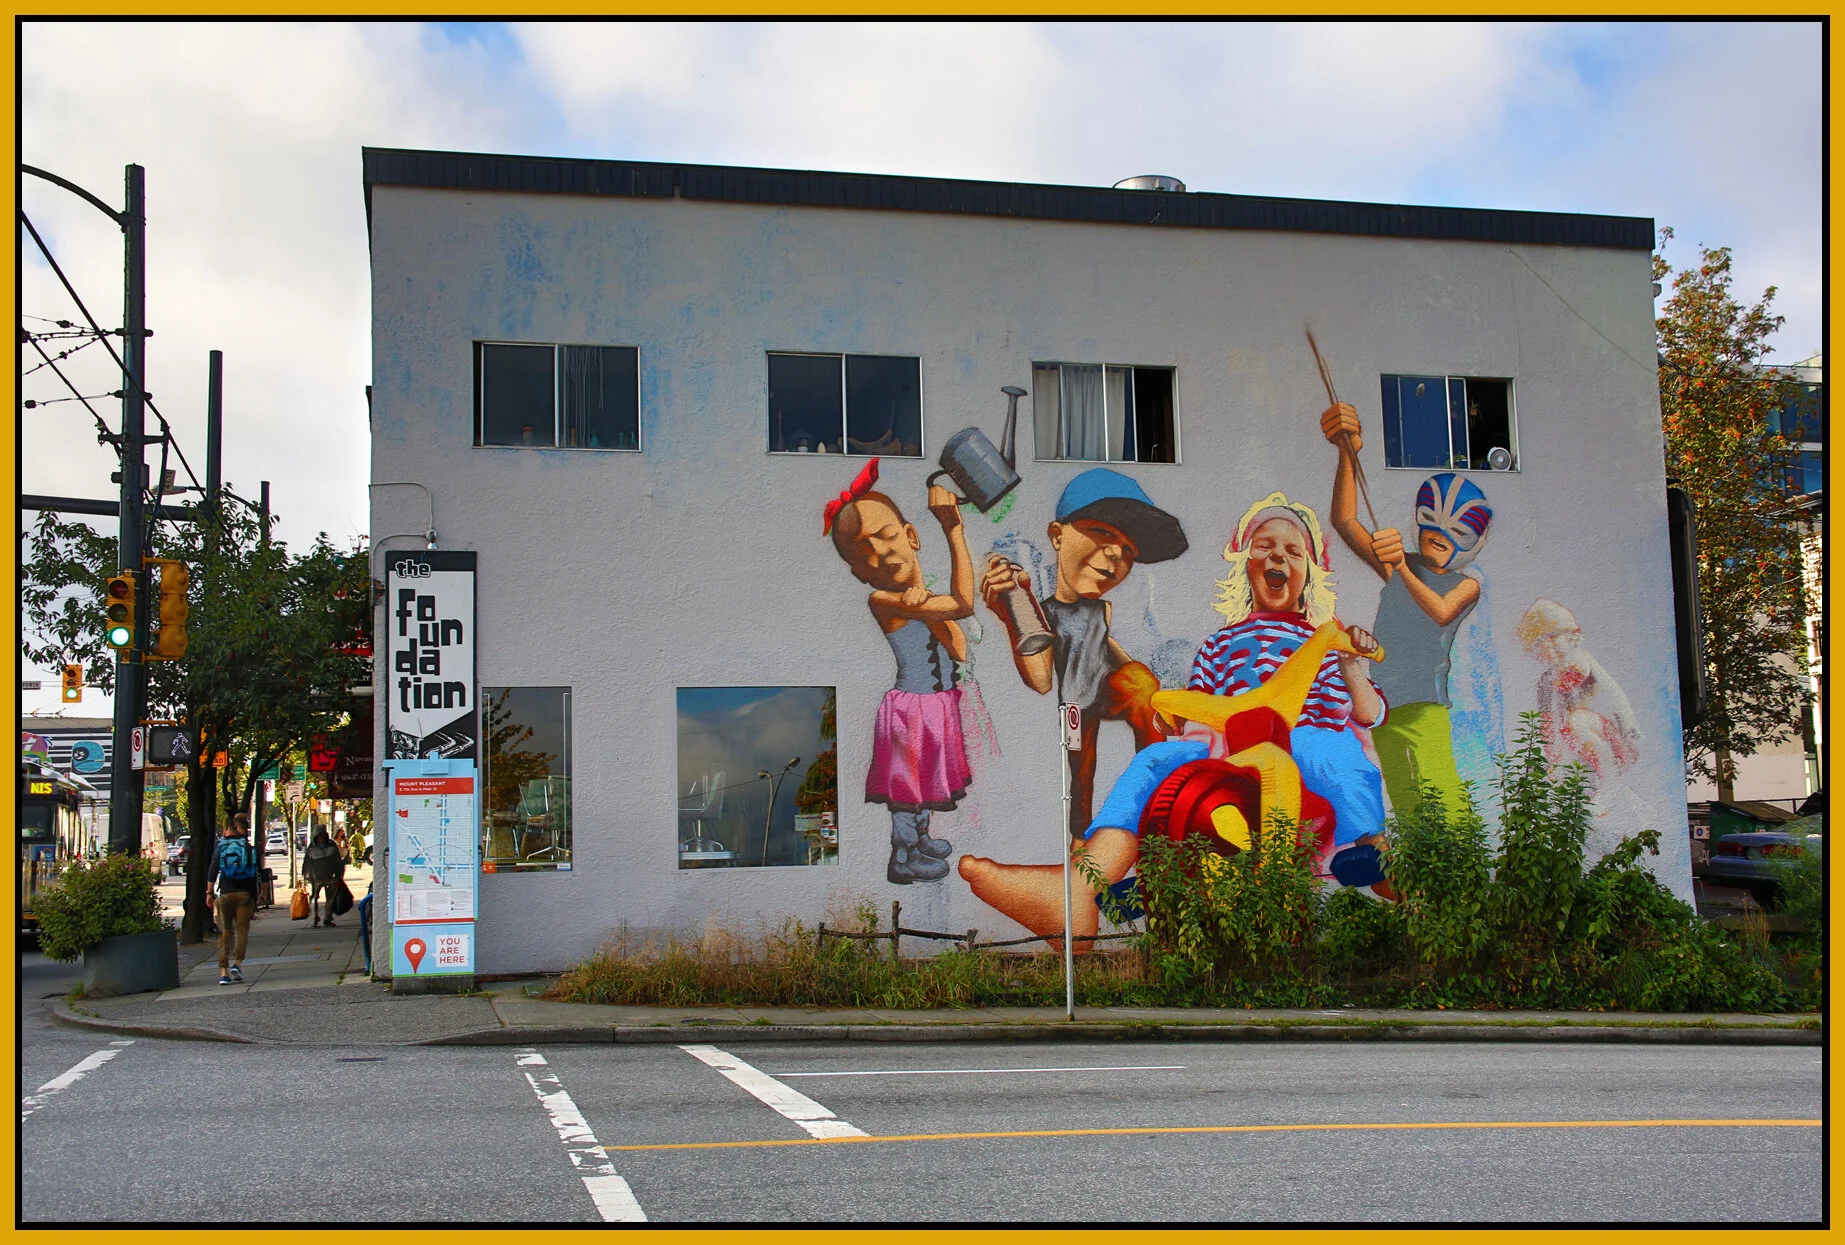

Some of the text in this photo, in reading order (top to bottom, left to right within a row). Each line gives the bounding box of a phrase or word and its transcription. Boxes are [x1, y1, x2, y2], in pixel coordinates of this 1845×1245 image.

[395, 558, 432, 579] the
[30, 782, 53, 794] NIS
[439, 937, 460, 946] YOU
[439, 946, 459, 955] ARE
[439, 955, 465, 964] HERE
